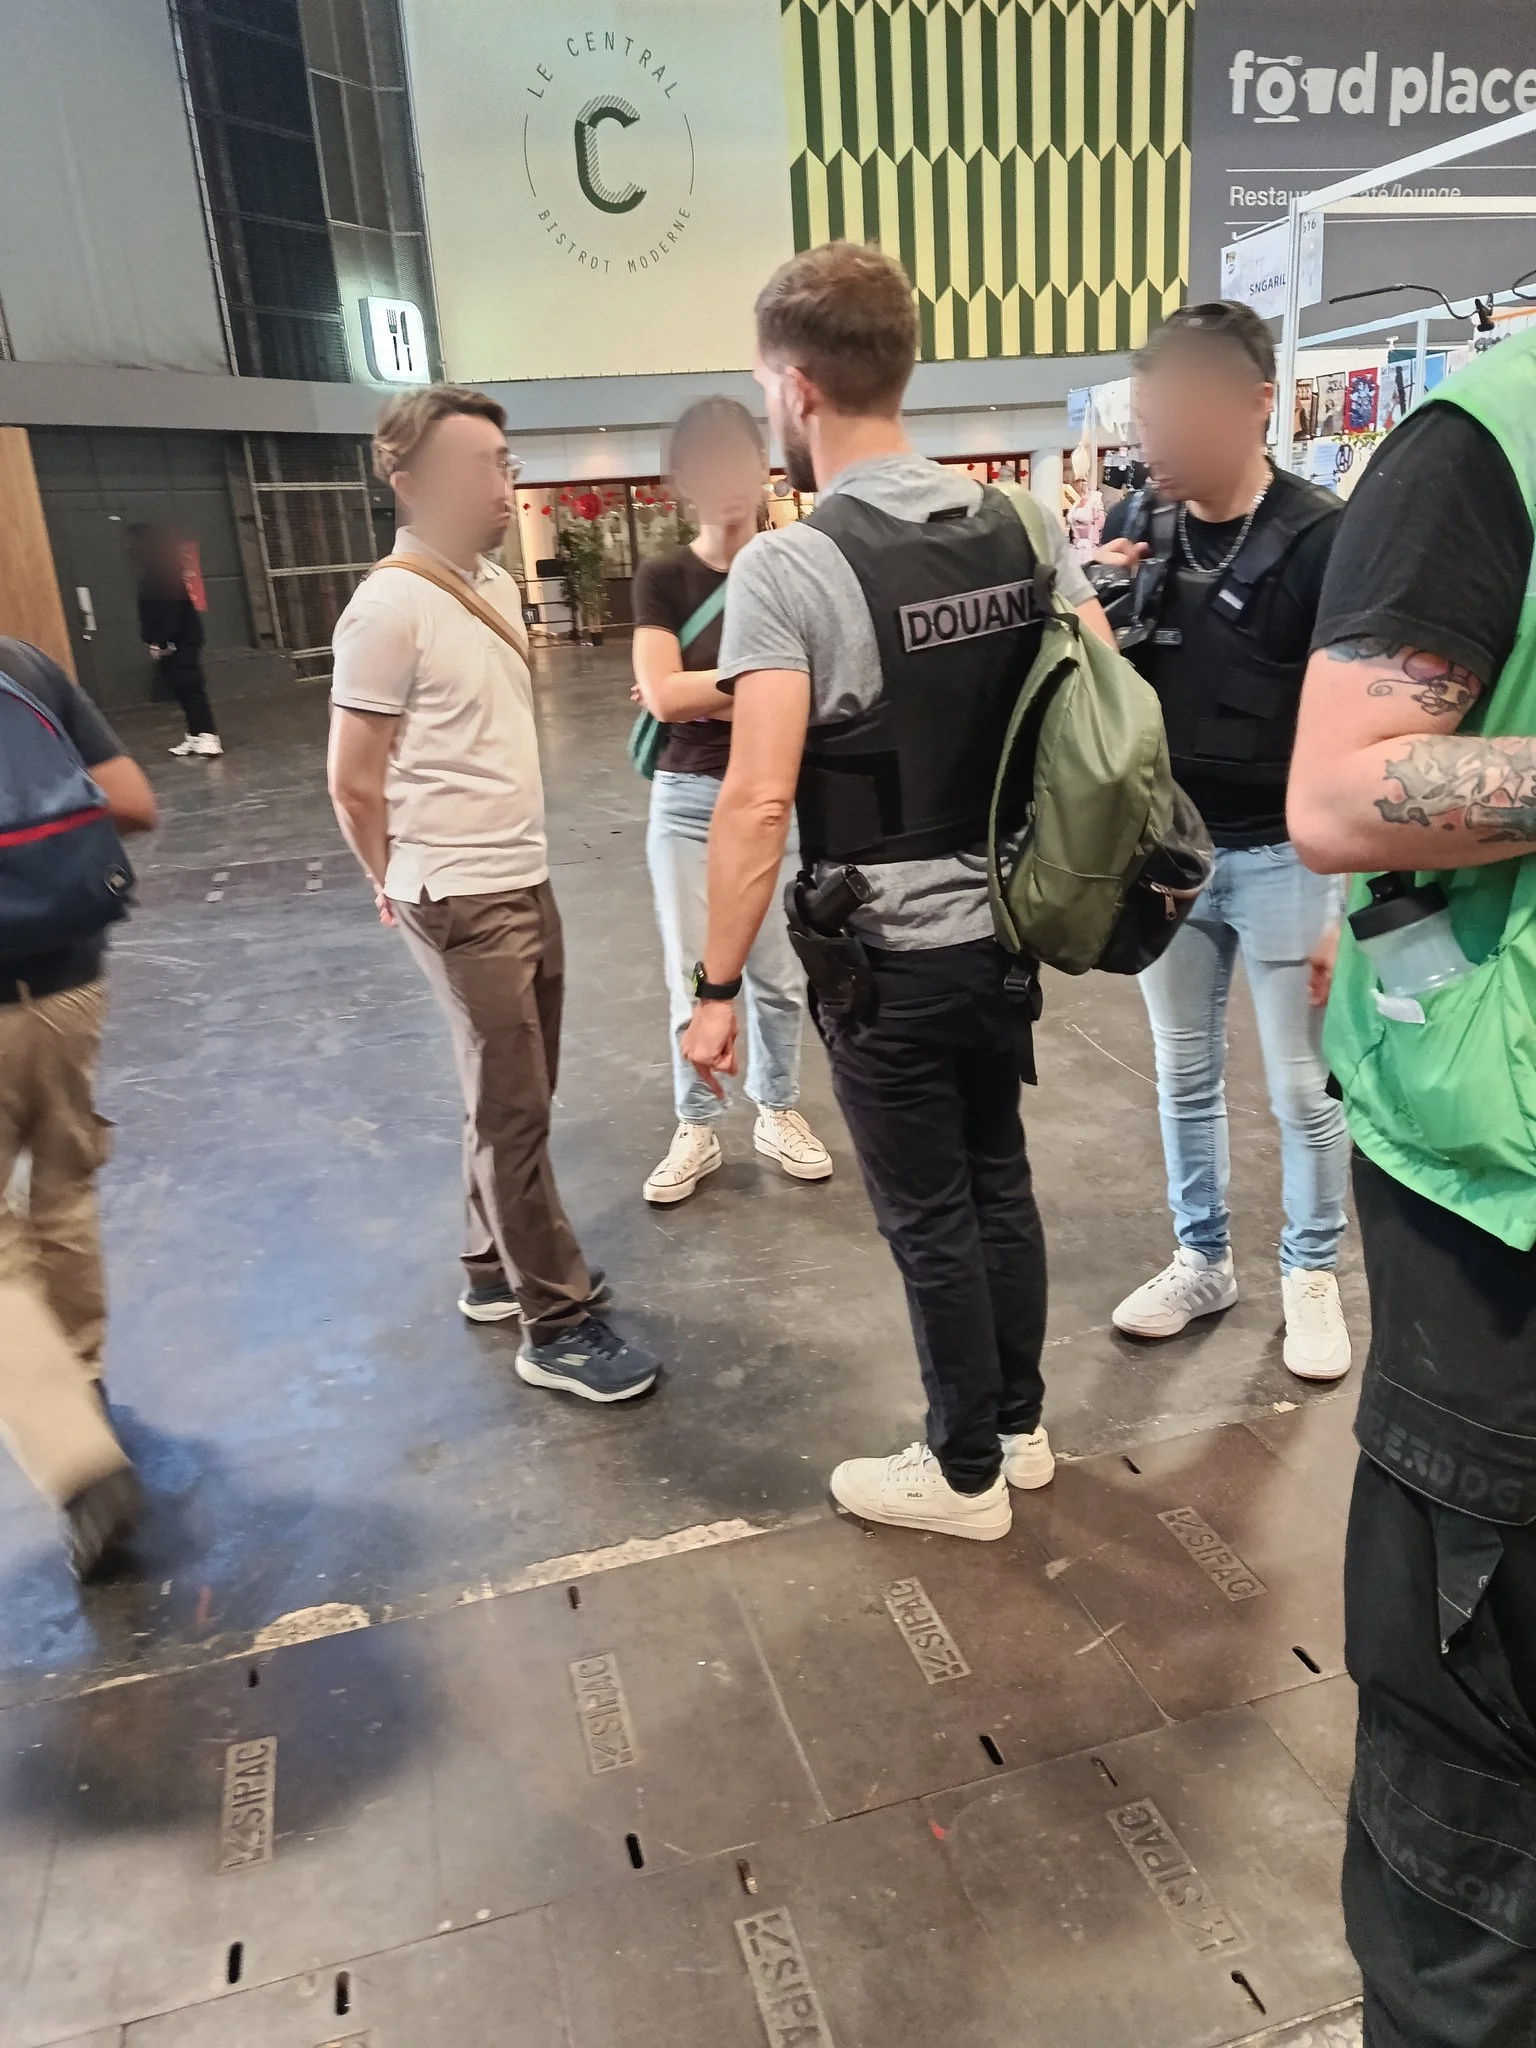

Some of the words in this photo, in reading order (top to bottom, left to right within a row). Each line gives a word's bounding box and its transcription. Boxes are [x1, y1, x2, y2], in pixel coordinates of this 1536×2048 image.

[527, 63, 553, 99] LE
[566, 31, 677, 99] CENTRAL
[1389, 52, 1536, 126] place
[538, 209, 610, 273] BISTROT
[628, 207, 691, 273] MODERNE
